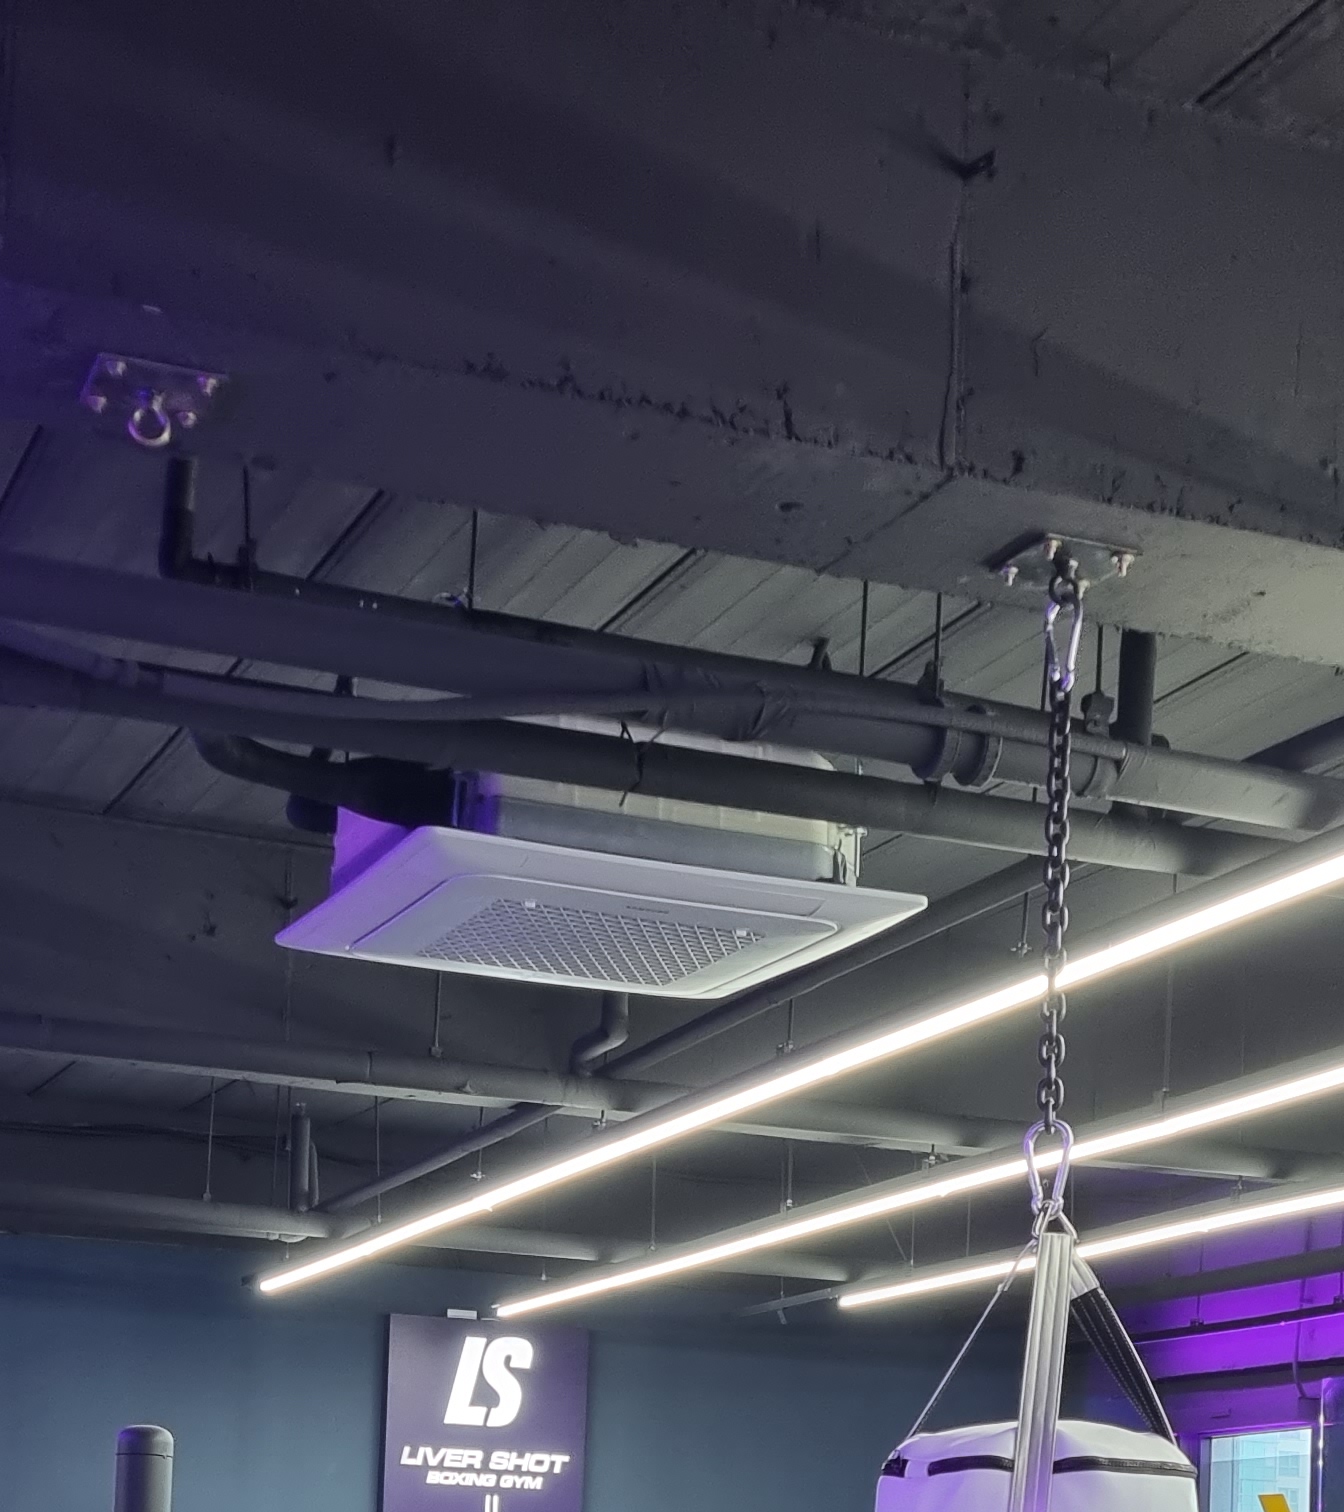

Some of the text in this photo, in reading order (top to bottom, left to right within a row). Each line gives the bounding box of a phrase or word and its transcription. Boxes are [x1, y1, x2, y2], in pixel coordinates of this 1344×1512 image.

[443, 1336, 534, 1428] LS
[400, 1445, 570, 1474] LIVER SHOT
[426, 1471, 544, 1491] BOXING GYM
